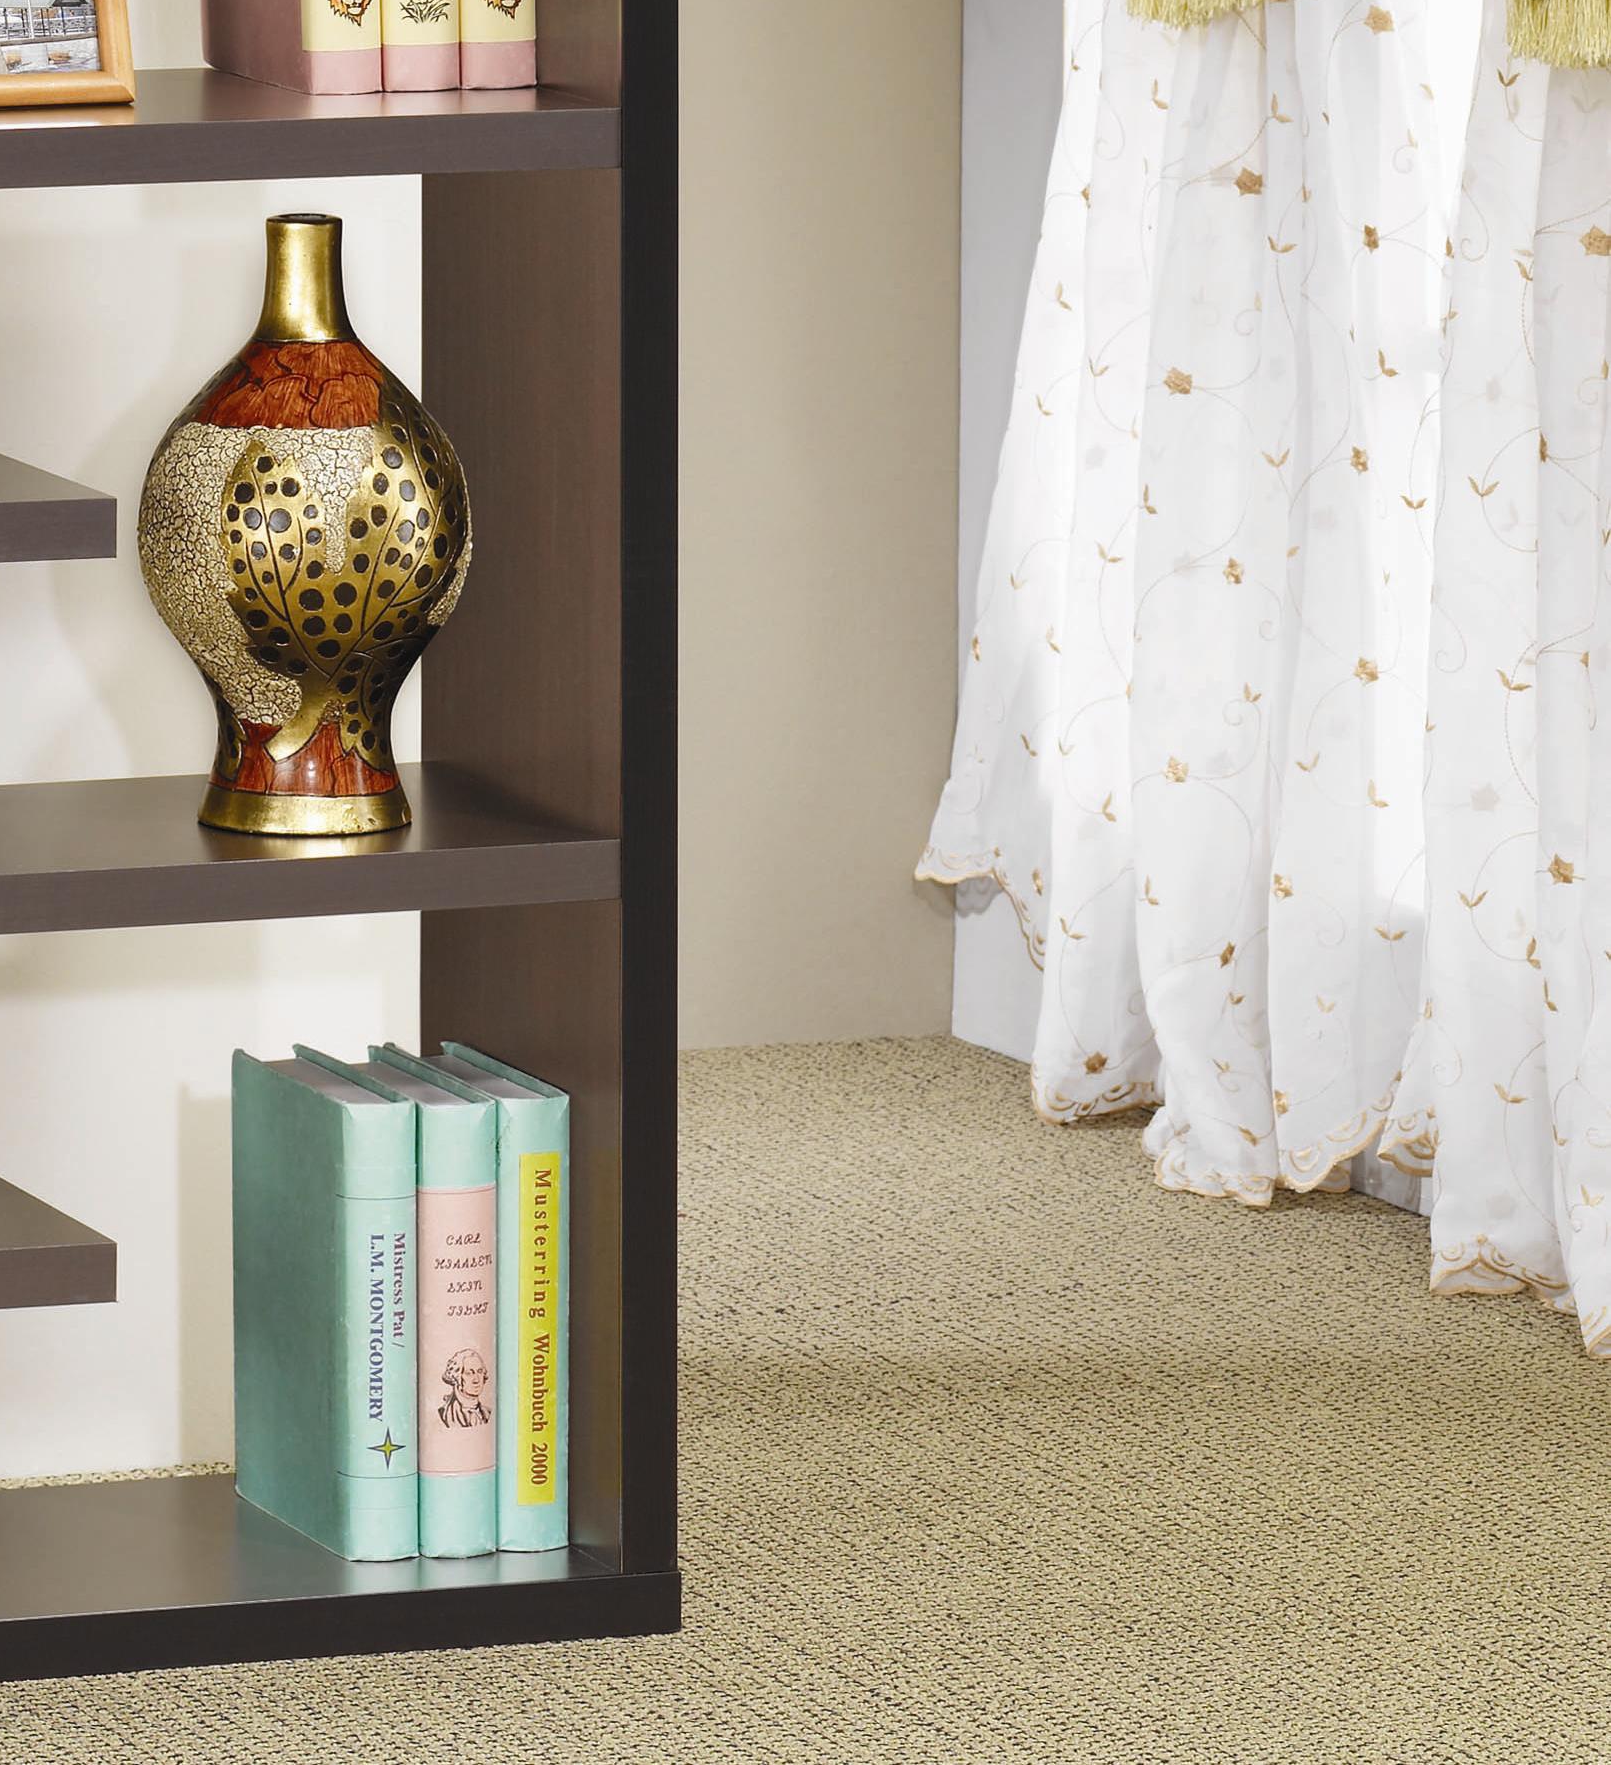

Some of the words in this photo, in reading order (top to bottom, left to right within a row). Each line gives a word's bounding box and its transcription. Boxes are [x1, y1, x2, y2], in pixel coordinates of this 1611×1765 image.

[393, 1232, 406, 1306] Mistress
[445, 1232, 481, 1246] CARL
[528, 1168, 552, 1319] Musterring
[368, 1279, 385, 1423] MONTGOMERY
[392, 1309, 406, 1339] Pat
[530, 1333, 551, 1433] Wohnbuch
[530, 1441, 549, 1486] 2000
